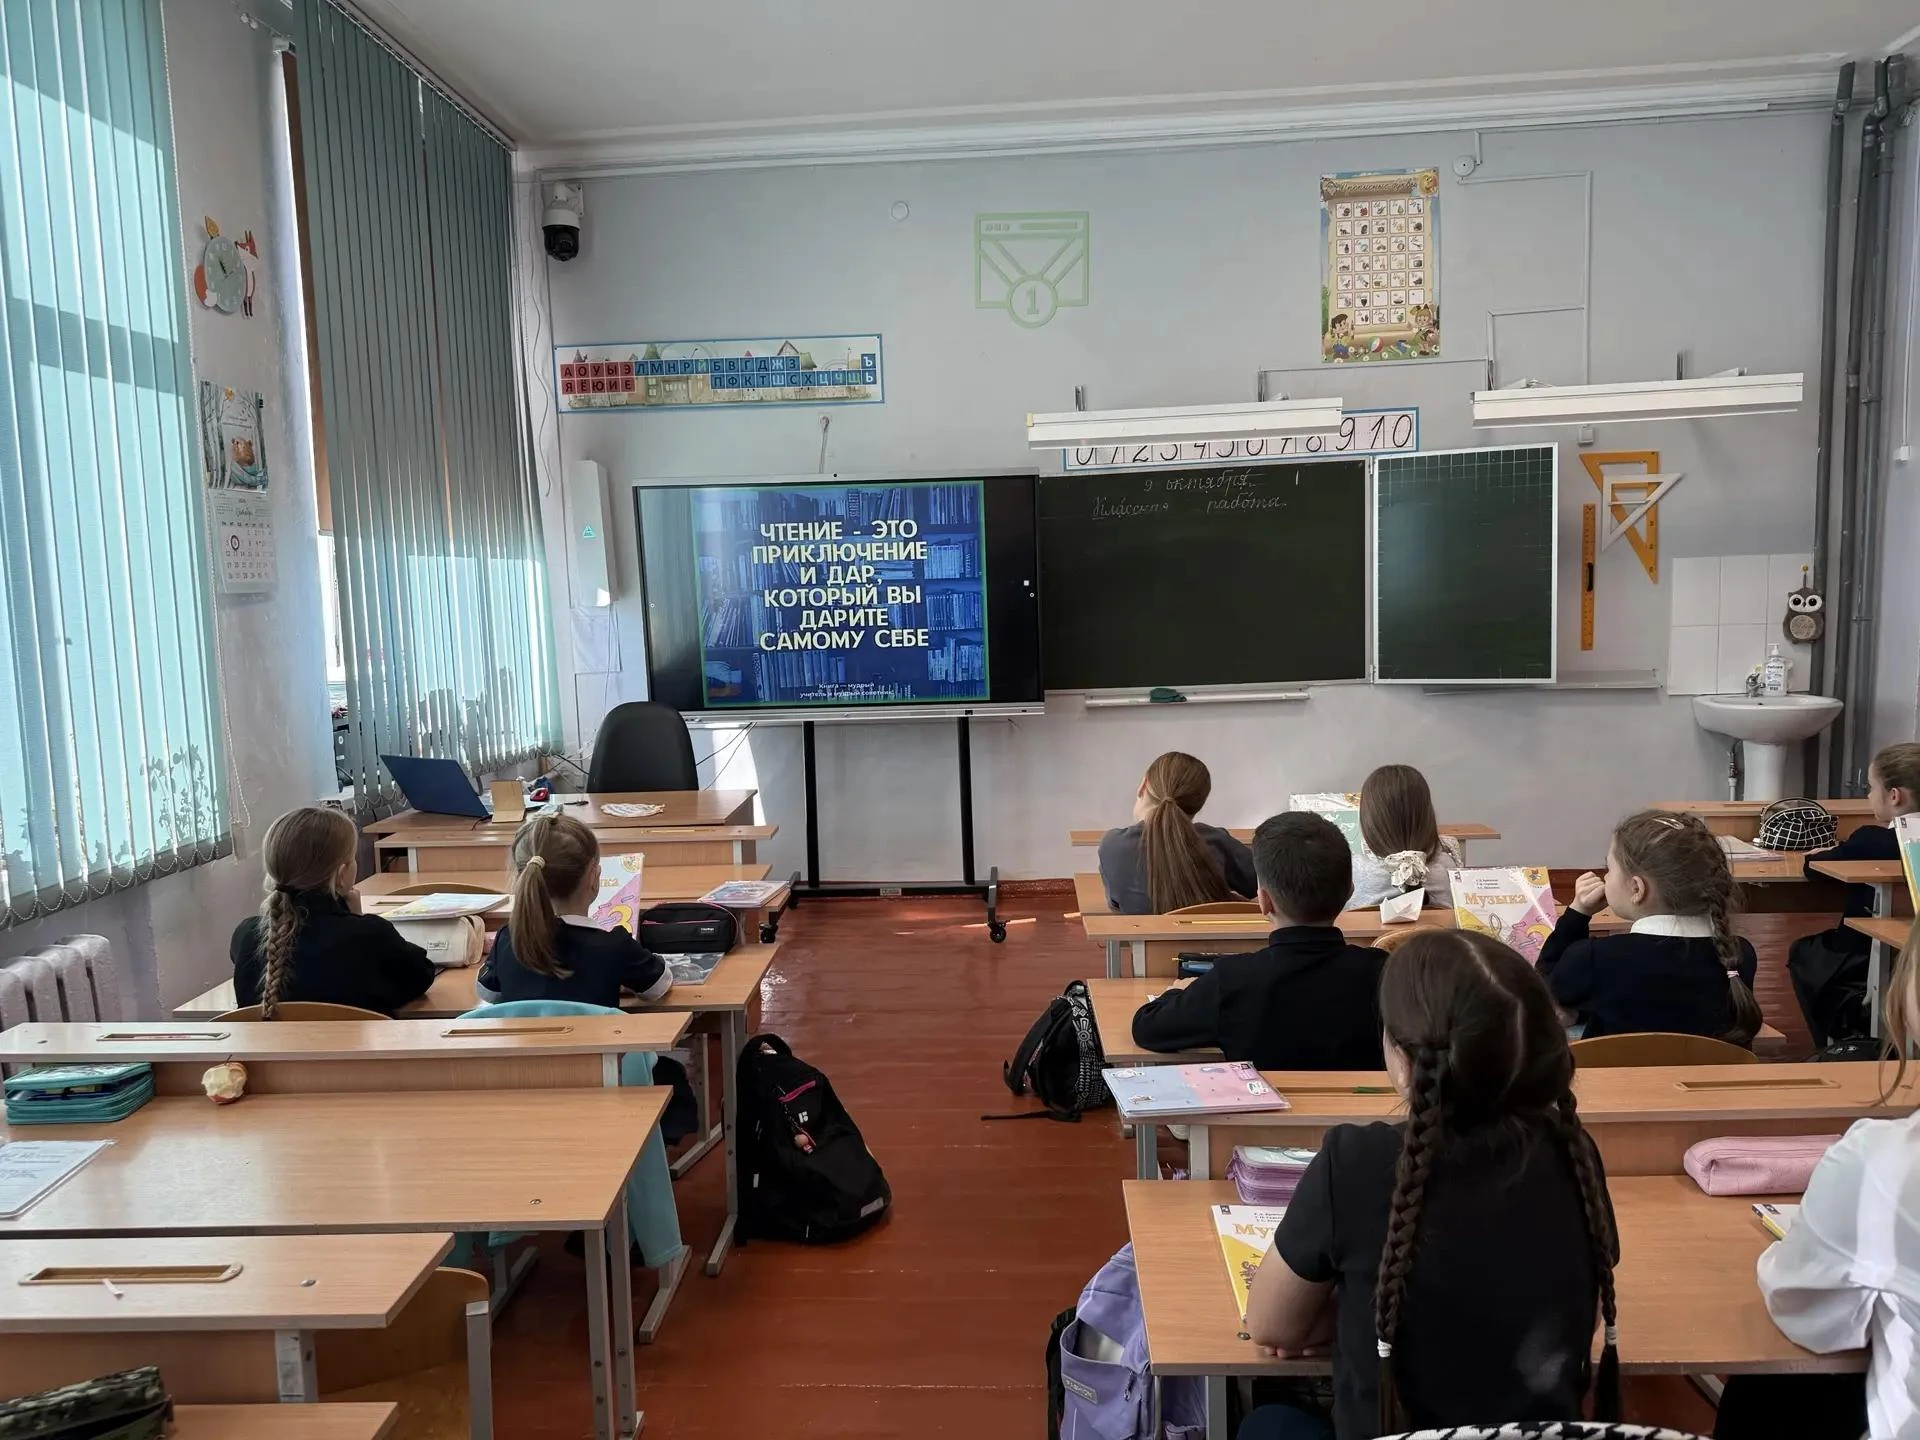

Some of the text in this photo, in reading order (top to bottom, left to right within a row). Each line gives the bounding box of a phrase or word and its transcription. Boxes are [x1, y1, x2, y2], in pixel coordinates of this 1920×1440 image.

[1026, 286, 1039, 314] 1
[1335, 416, 1355, 450] 9
[1143, 479, 1153, 492] 9
[760, 520, 843, 542] ЧТЕНИЕ
[871, 519, 918, 539] ЭТО
[752, 541, 928, 564] ПРИКЛЮЧЕНИЕ
[800, 565, 882, 587] И ДАР,
[764, 583, 921, 608] КОТОРЫЙ ВЫ
[800, 608, 889, 631] ДАРИТЕ
[760, 628, 929, 651] САМОМУ СЕБЕ
[799, 689, 827, 699] учитель
[847, 681, 875, 690] мудрый
[1464, 892, 1528, 909] Музыка
